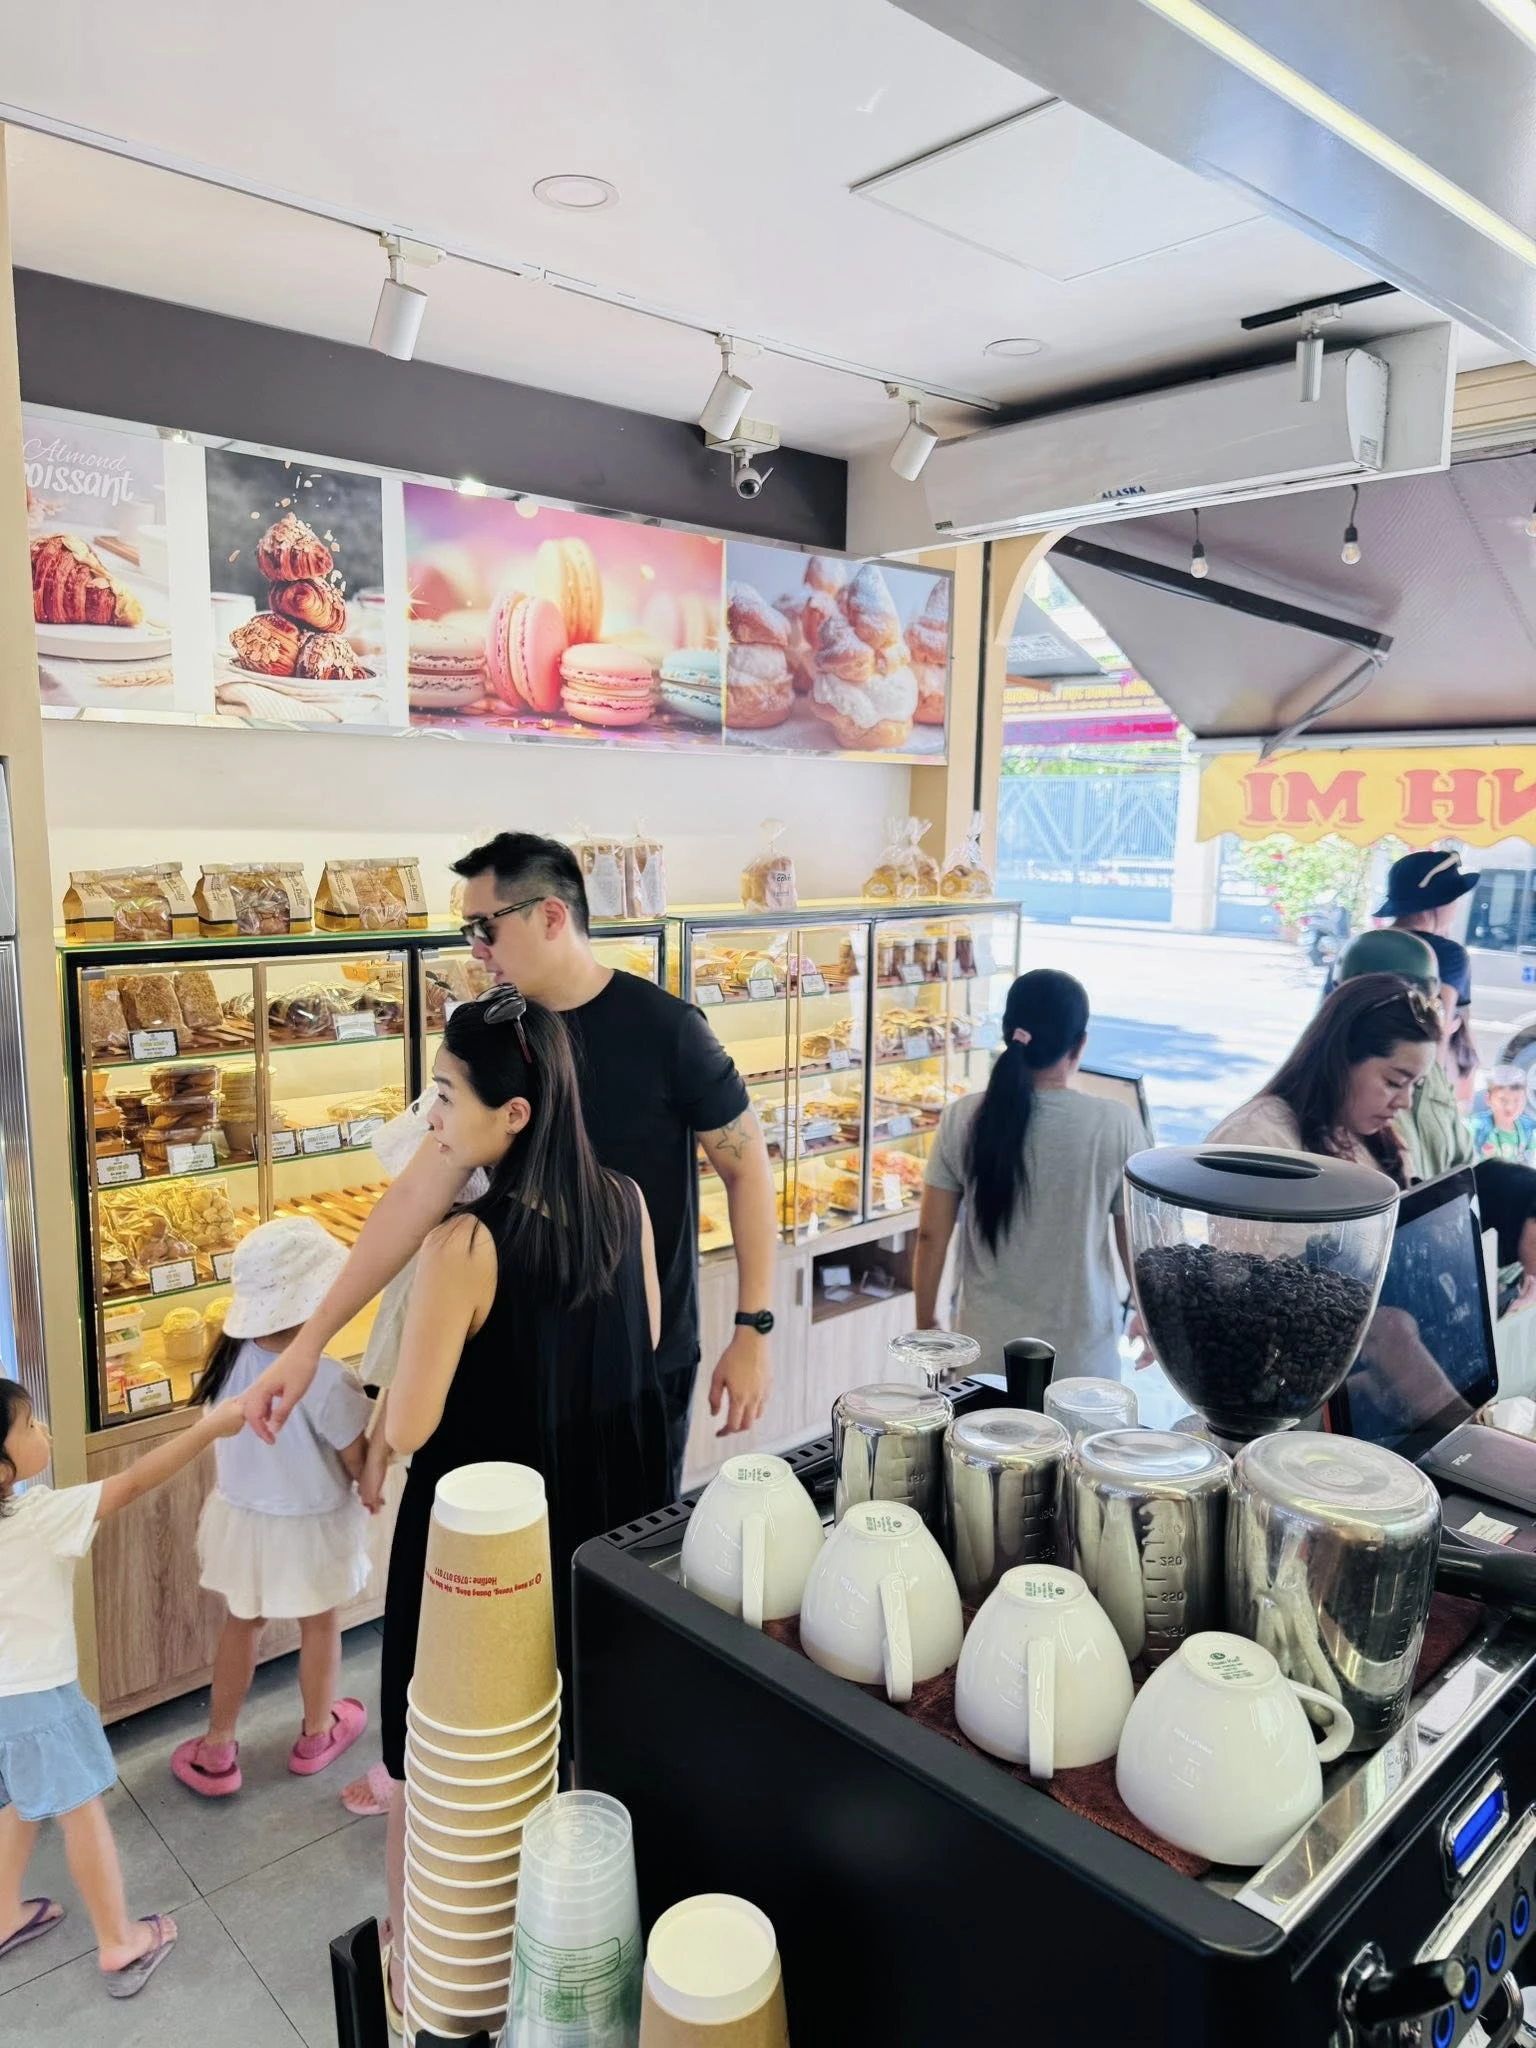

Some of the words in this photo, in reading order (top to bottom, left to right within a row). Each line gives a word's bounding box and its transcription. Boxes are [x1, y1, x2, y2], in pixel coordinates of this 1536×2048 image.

[23, 438, 127, 471] Almond
[24, 462, 134, 506] oissant
[1101, 485, 1147, 499] ALASKA
[473, 1576, 497, 1587] Hotline
